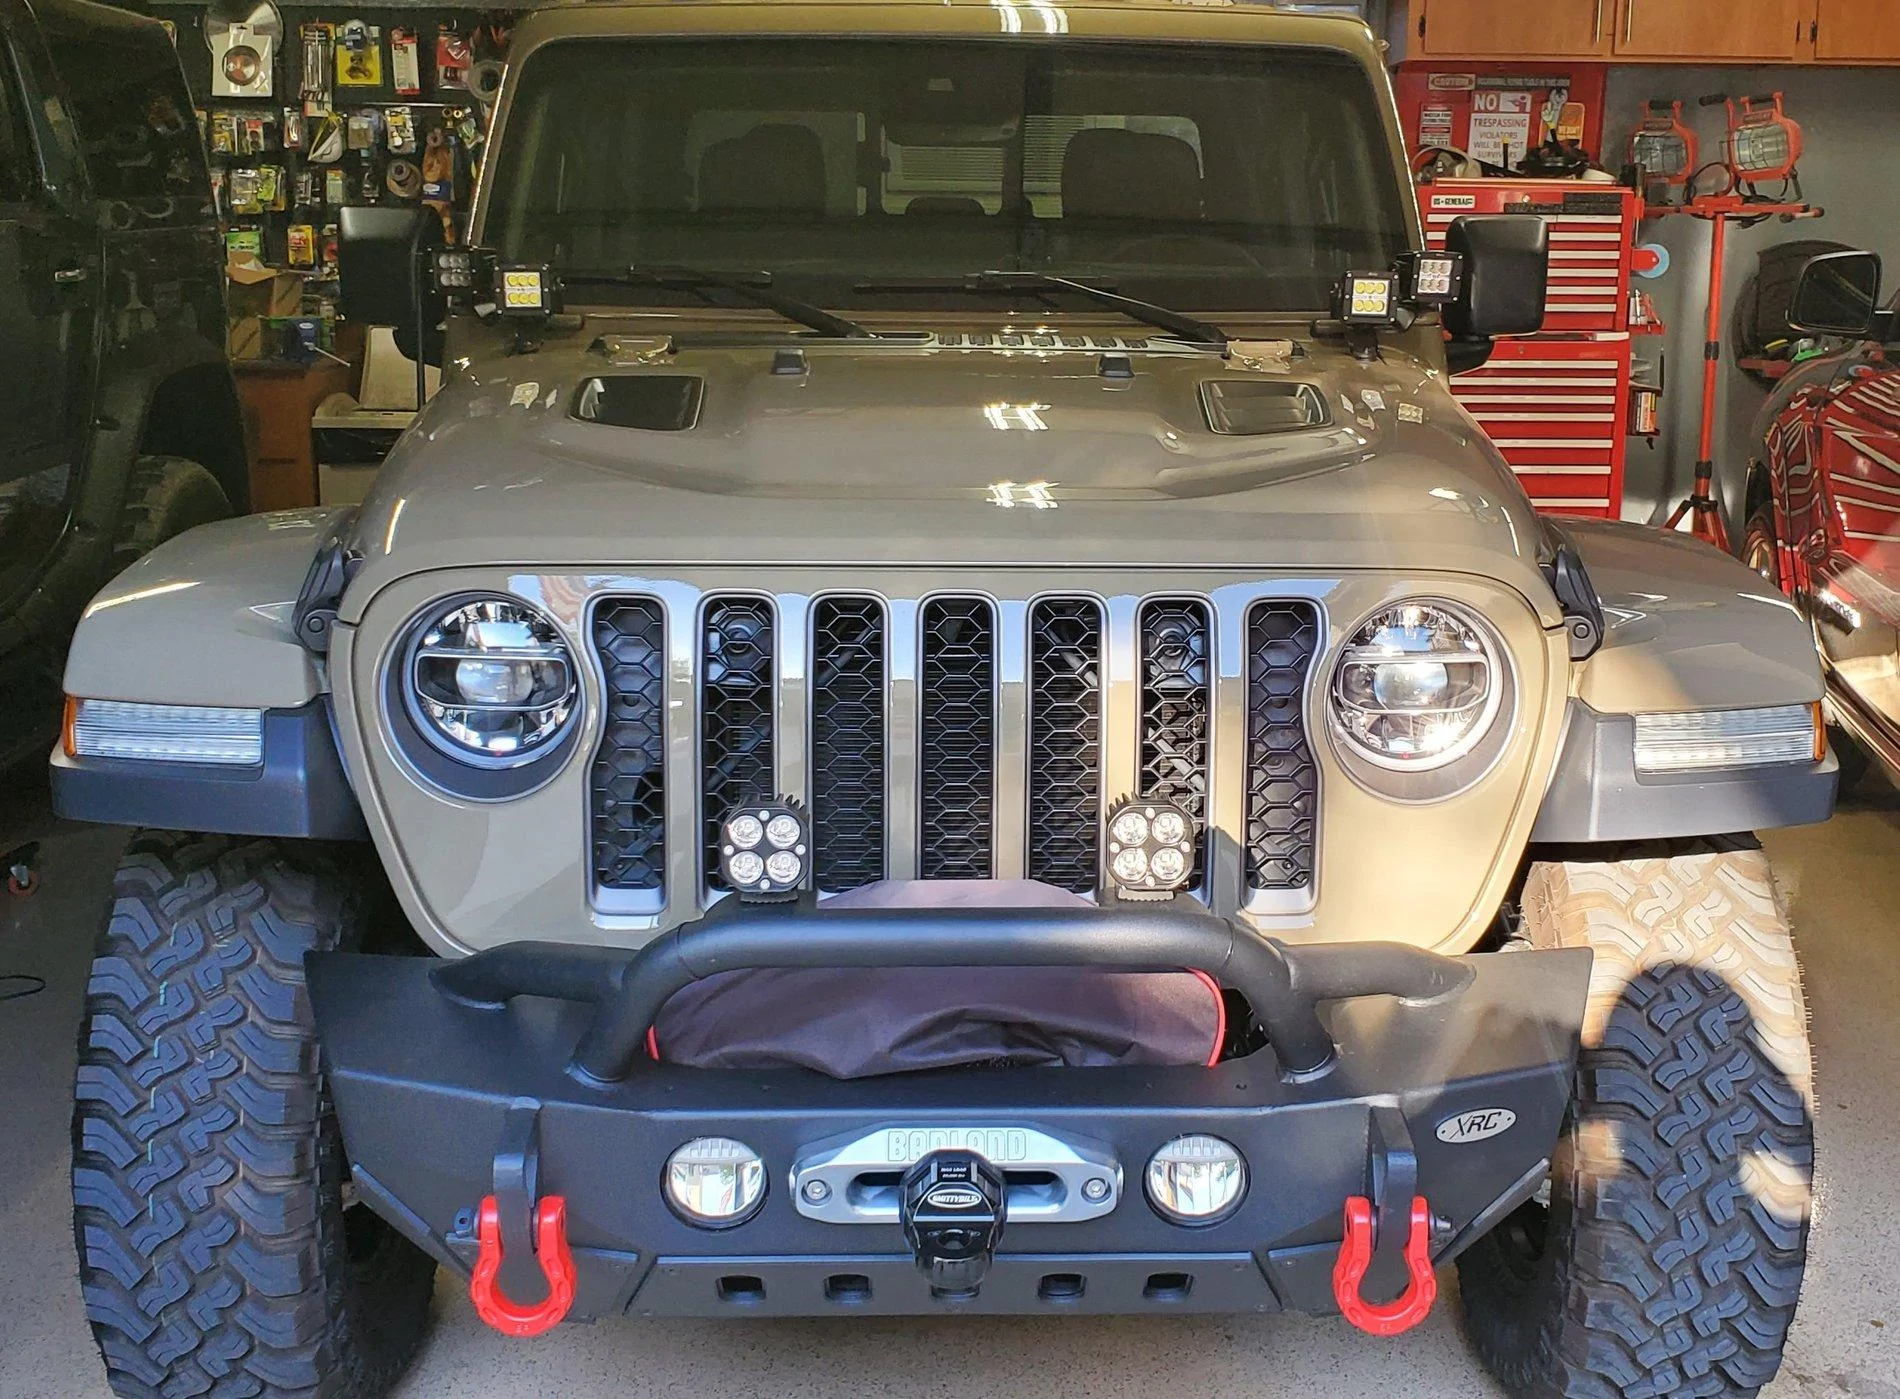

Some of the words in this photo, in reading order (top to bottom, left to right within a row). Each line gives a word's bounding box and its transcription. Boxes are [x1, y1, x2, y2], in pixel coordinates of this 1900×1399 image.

[1474, 94, 1497, 111] NO
[1474, 118, 1527, 128] TRESPASSING
[1477, 151, 1517, 159] SURVIVRS
[1448, 1111, 1502, 1139] XRC
